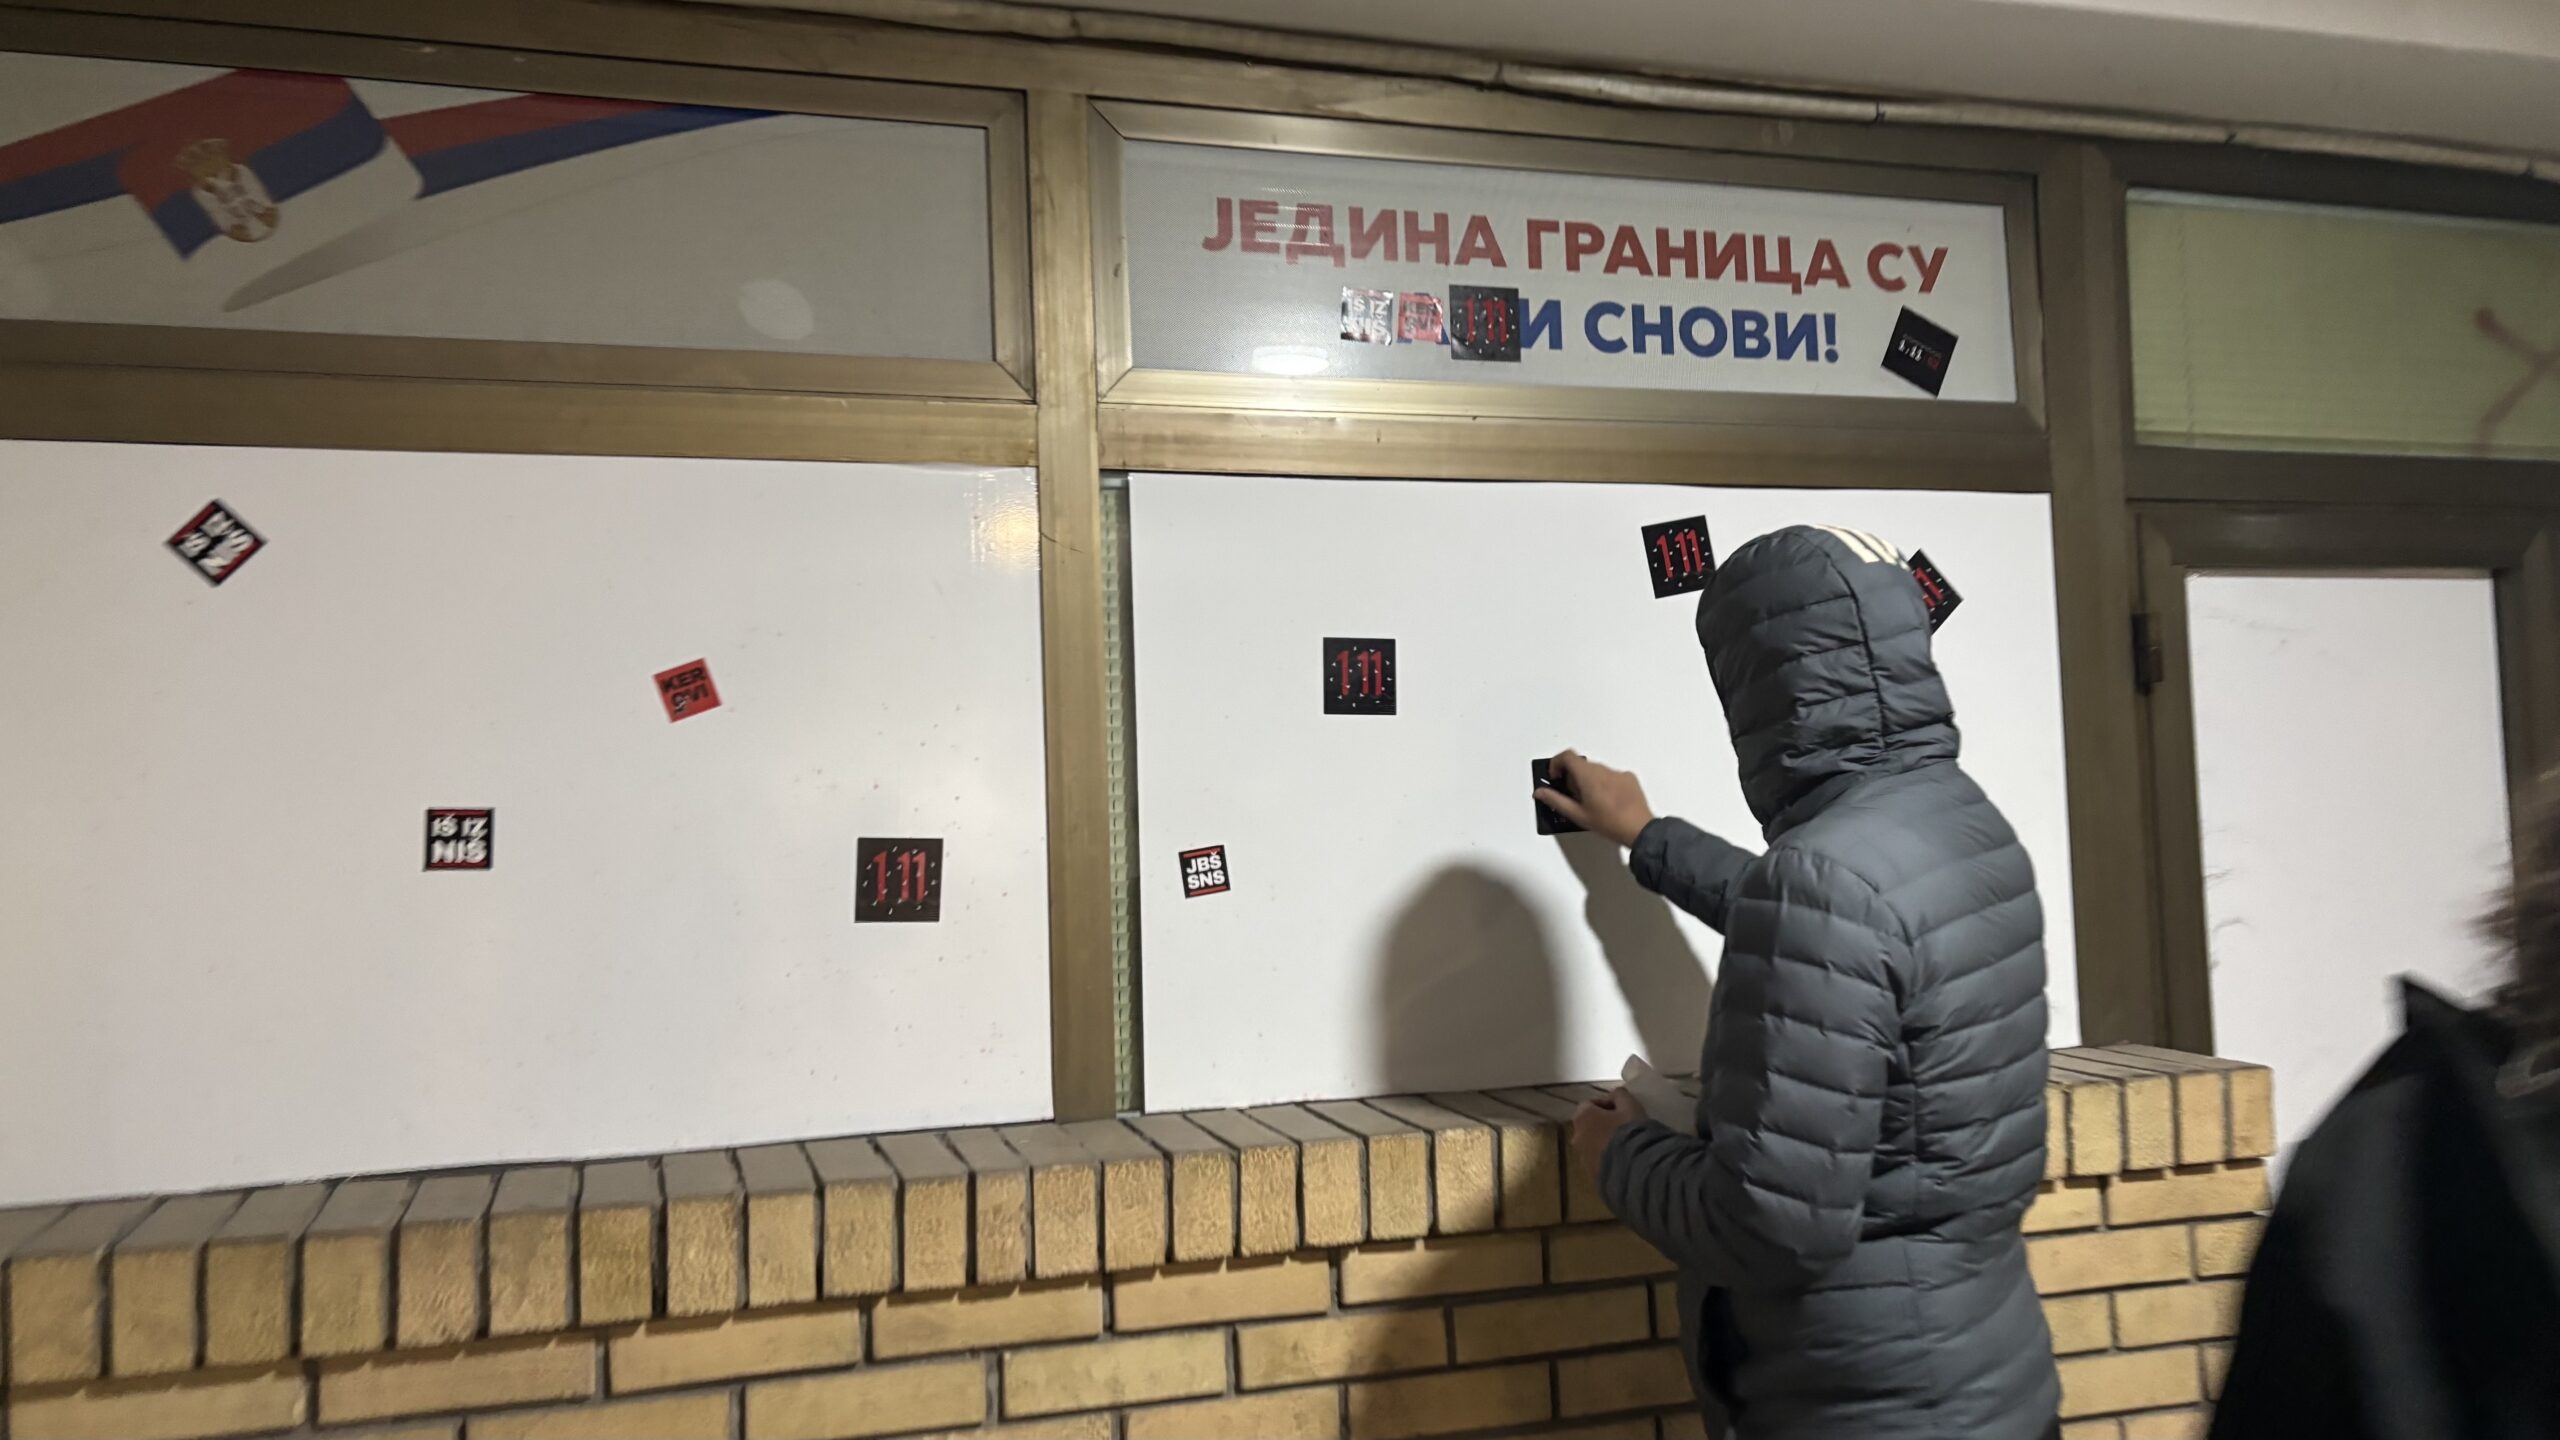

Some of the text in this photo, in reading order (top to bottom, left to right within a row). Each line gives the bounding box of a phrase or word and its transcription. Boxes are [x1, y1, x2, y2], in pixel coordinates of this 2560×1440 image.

[1202, 197, 1949, 296] ЈЕДИНА ГРАНИЦА СУ
[1584, 301, 1840, 364] СНОВИ!
[1186, 851, 1222, 874] JBŠ
[1187, 869, 1226, 890] SNS
